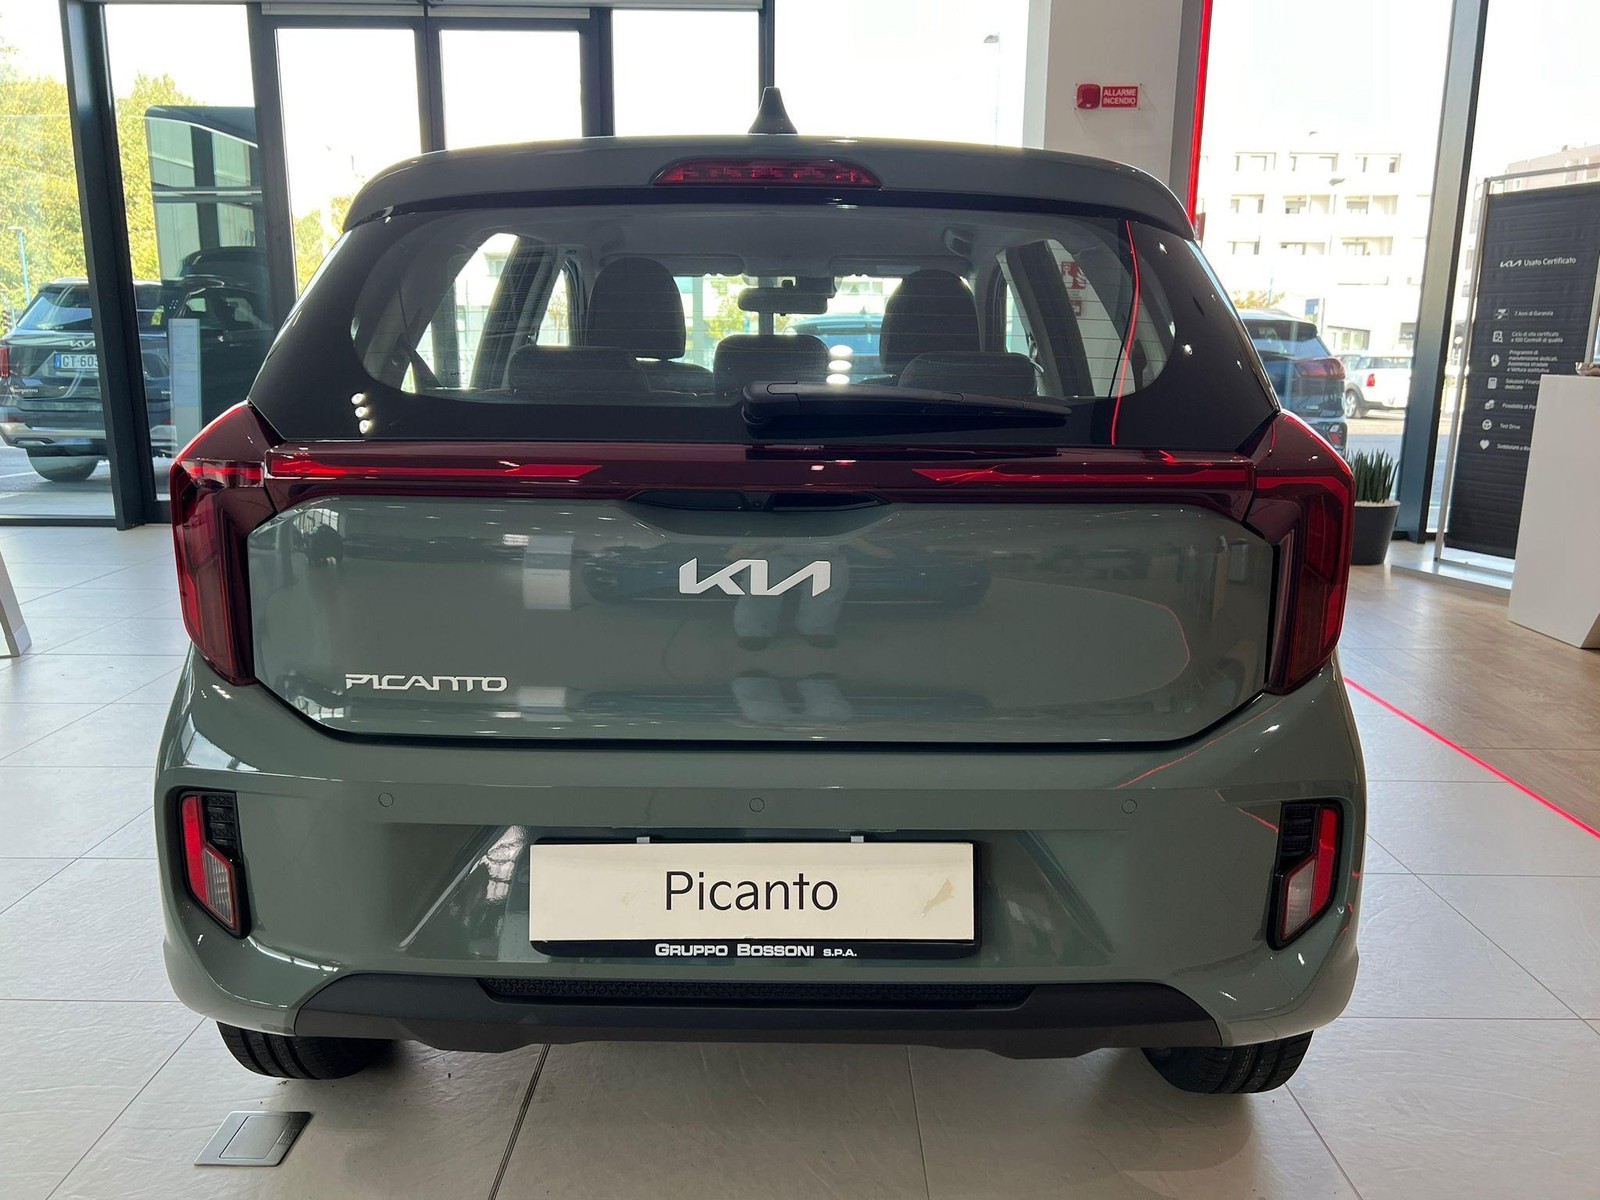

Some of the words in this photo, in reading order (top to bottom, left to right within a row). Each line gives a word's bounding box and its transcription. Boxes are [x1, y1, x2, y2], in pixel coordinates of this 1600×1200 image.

[1103, 88, 1137, 97] ALLARME
[1103, 97, 1136, 105] INCENDIO
[1523, 258, 1542, 267] Usato
[1542, 257, 1577, 266] Certificato
[63, 356, 77, 367] GT
[678, 557, 831, 597] KIA
[345, 673, 508, 693] PICANTO
[665, 871, 839, 911] Picanto
[654, 943, 729, 957] GRUPPO
[737, 943, 815, 957] BOSSONI
[823, 948, 857, 957] S.P.A.
